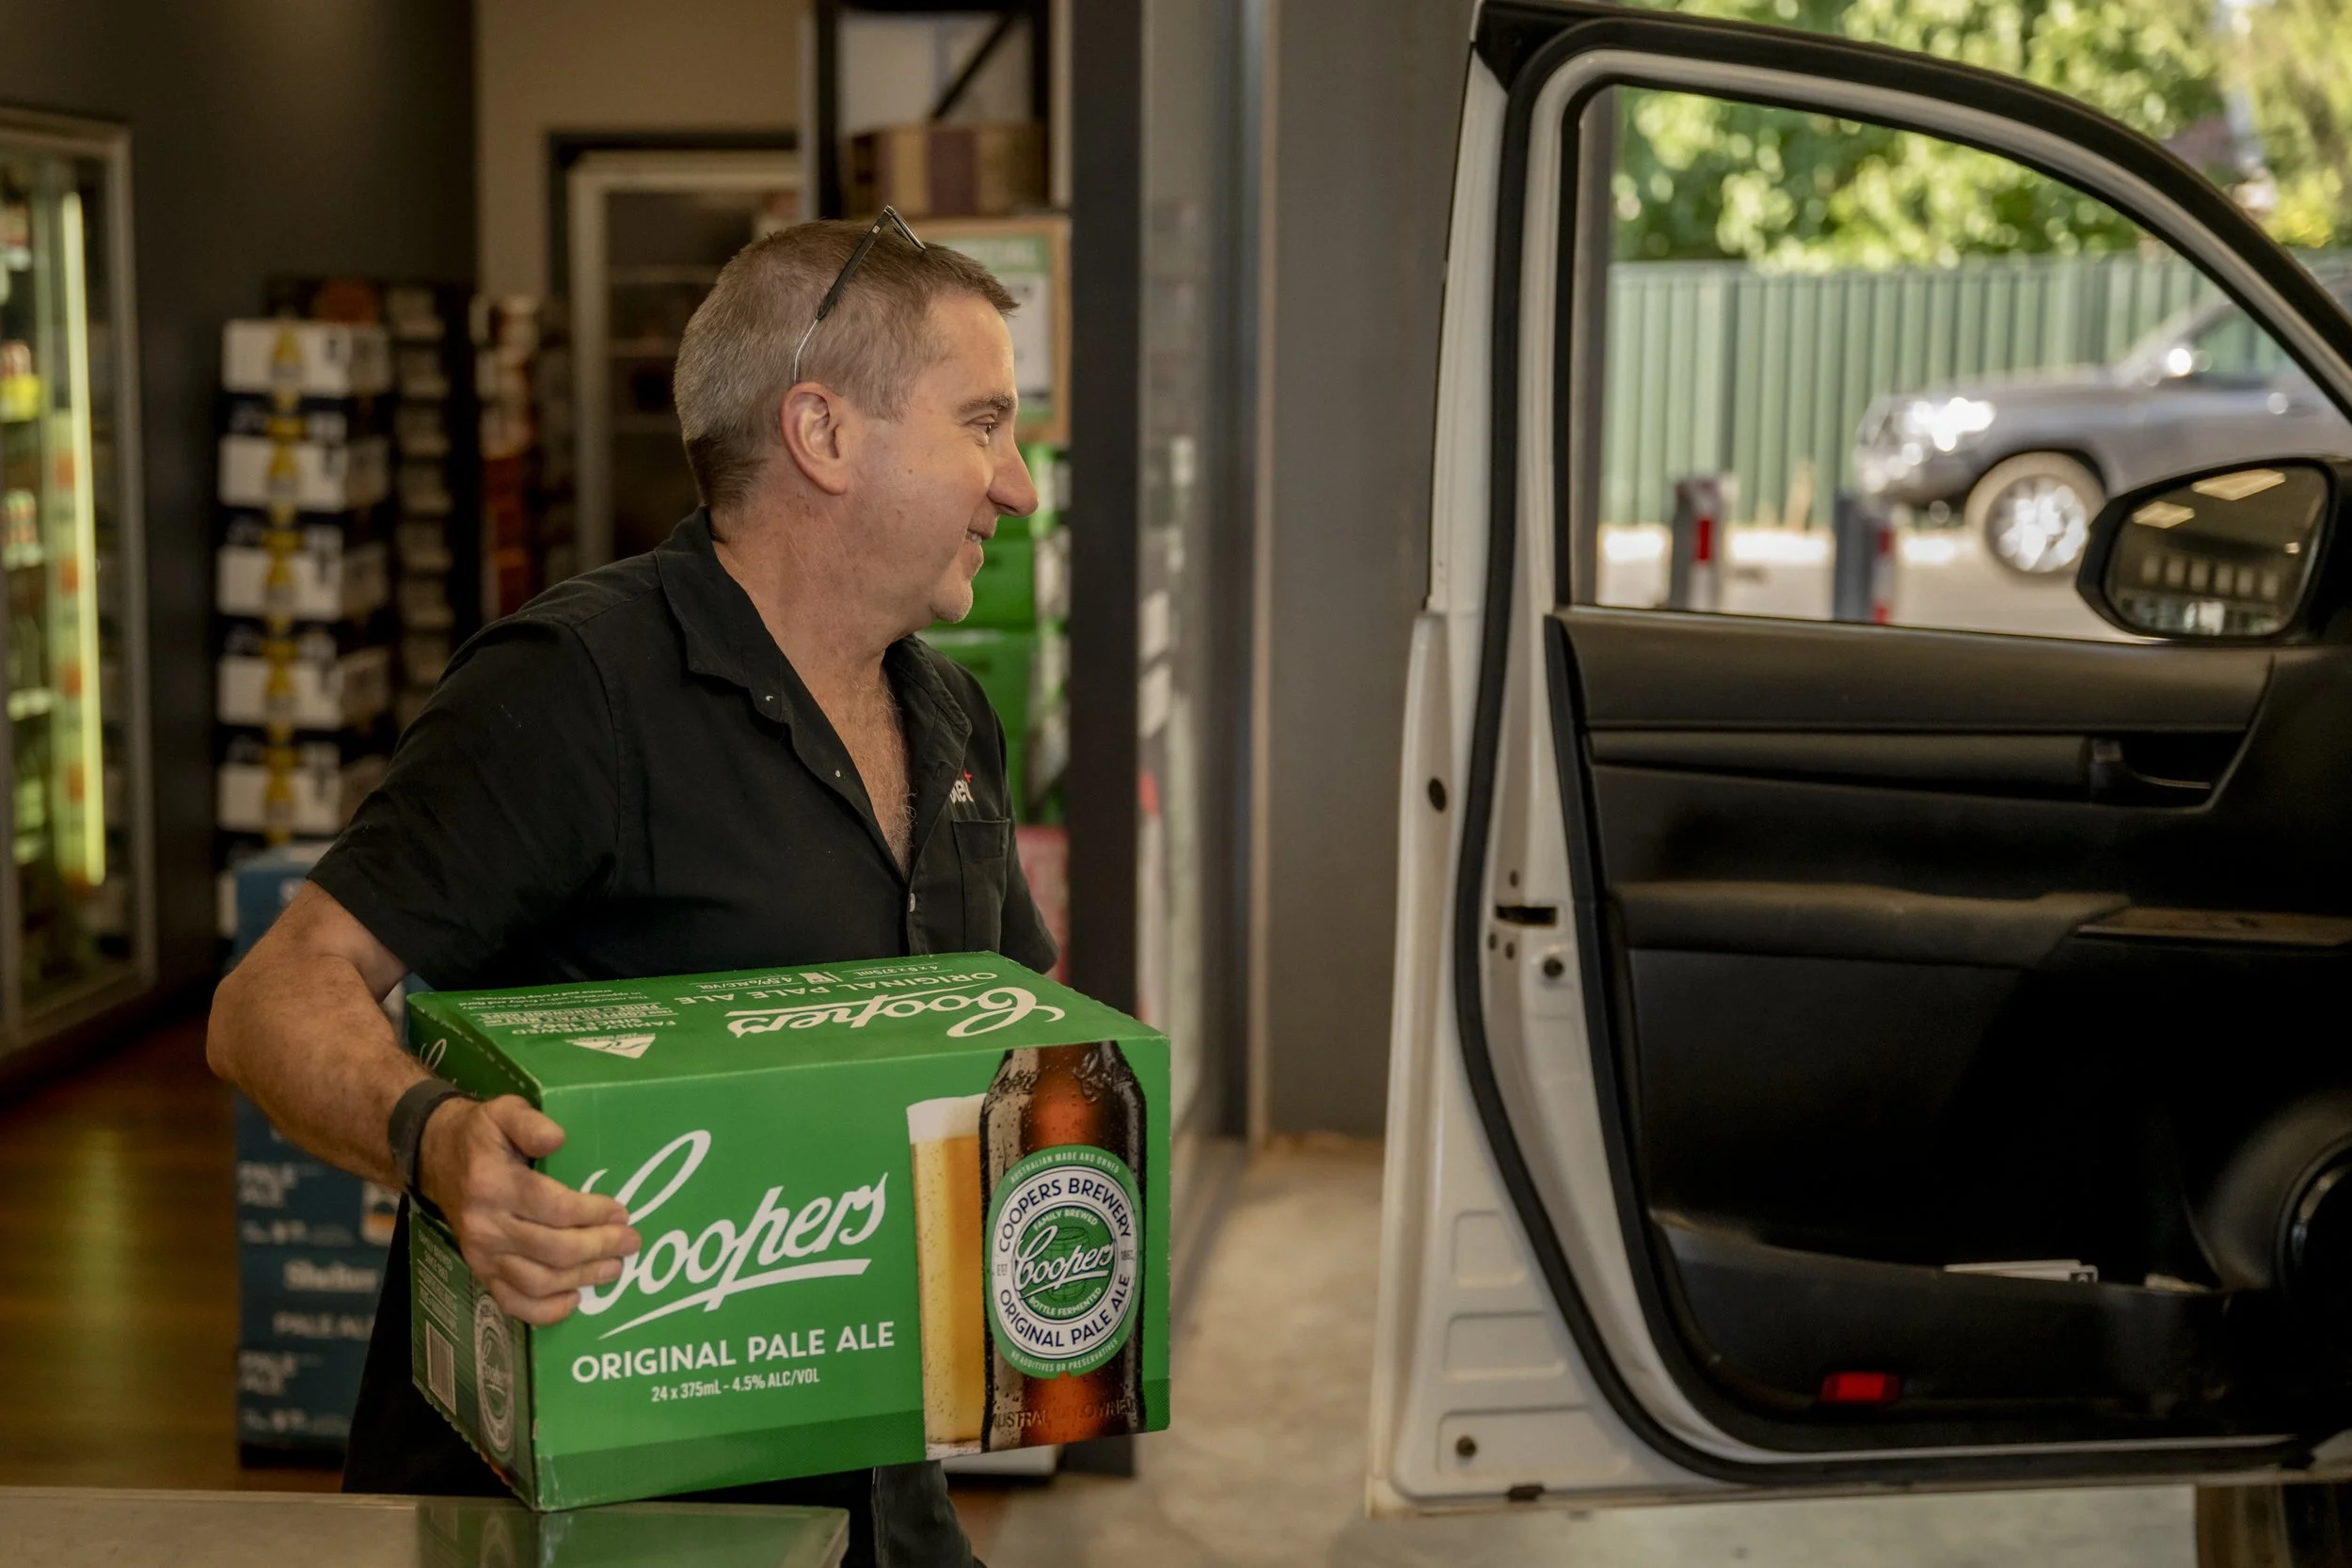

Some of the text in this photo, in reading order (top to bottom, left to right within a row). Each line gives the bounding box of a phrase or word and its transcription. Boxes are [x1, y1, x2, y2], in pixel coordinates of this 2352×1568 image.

[746, 986, 831, 999] PALE
[836, 972, 997, 990] ORIGINAL
[675, 993, 734, 1005] ALE
[724, 982, 1065, 1038] Coopers
[512, 1021, 676, 1035] FAMILY BREWED
[586, 1019, 643, 1028] SINCE
[1009, 1151, 1120, 1183] AUSTRALIAN MADE AND OWNED
[999, 1178, 1131, 1253] COOPERS BREWERY
[1034, 1208, 1099, 1231] FAMILY BREWED
[1014, 1225, 1115, 1300] Coopers
[1000, 1274, 1131, 1347] ORIGINAL PALE ALE
[1028, 1287, 1102, 1316] BOTTLE FERMENTED
[572, 1321, 895, 1384] ORIGINAL PALE ALE
[1020, 1356, 1055, 1372] ADDITIVES
[1056, 1362, 1067, 1372] OR
[1068, 1338, 1120, 1370] PRESERVATIVES
[651, 1386, 668, 1402] 24
[671, 1387, 679, 1401] x
[680, 1379, 723, 1399] 375mL
[732, 1374, 766, 1392] 4.5%
[767, 1368, 820, 1388] ALC/VOL
